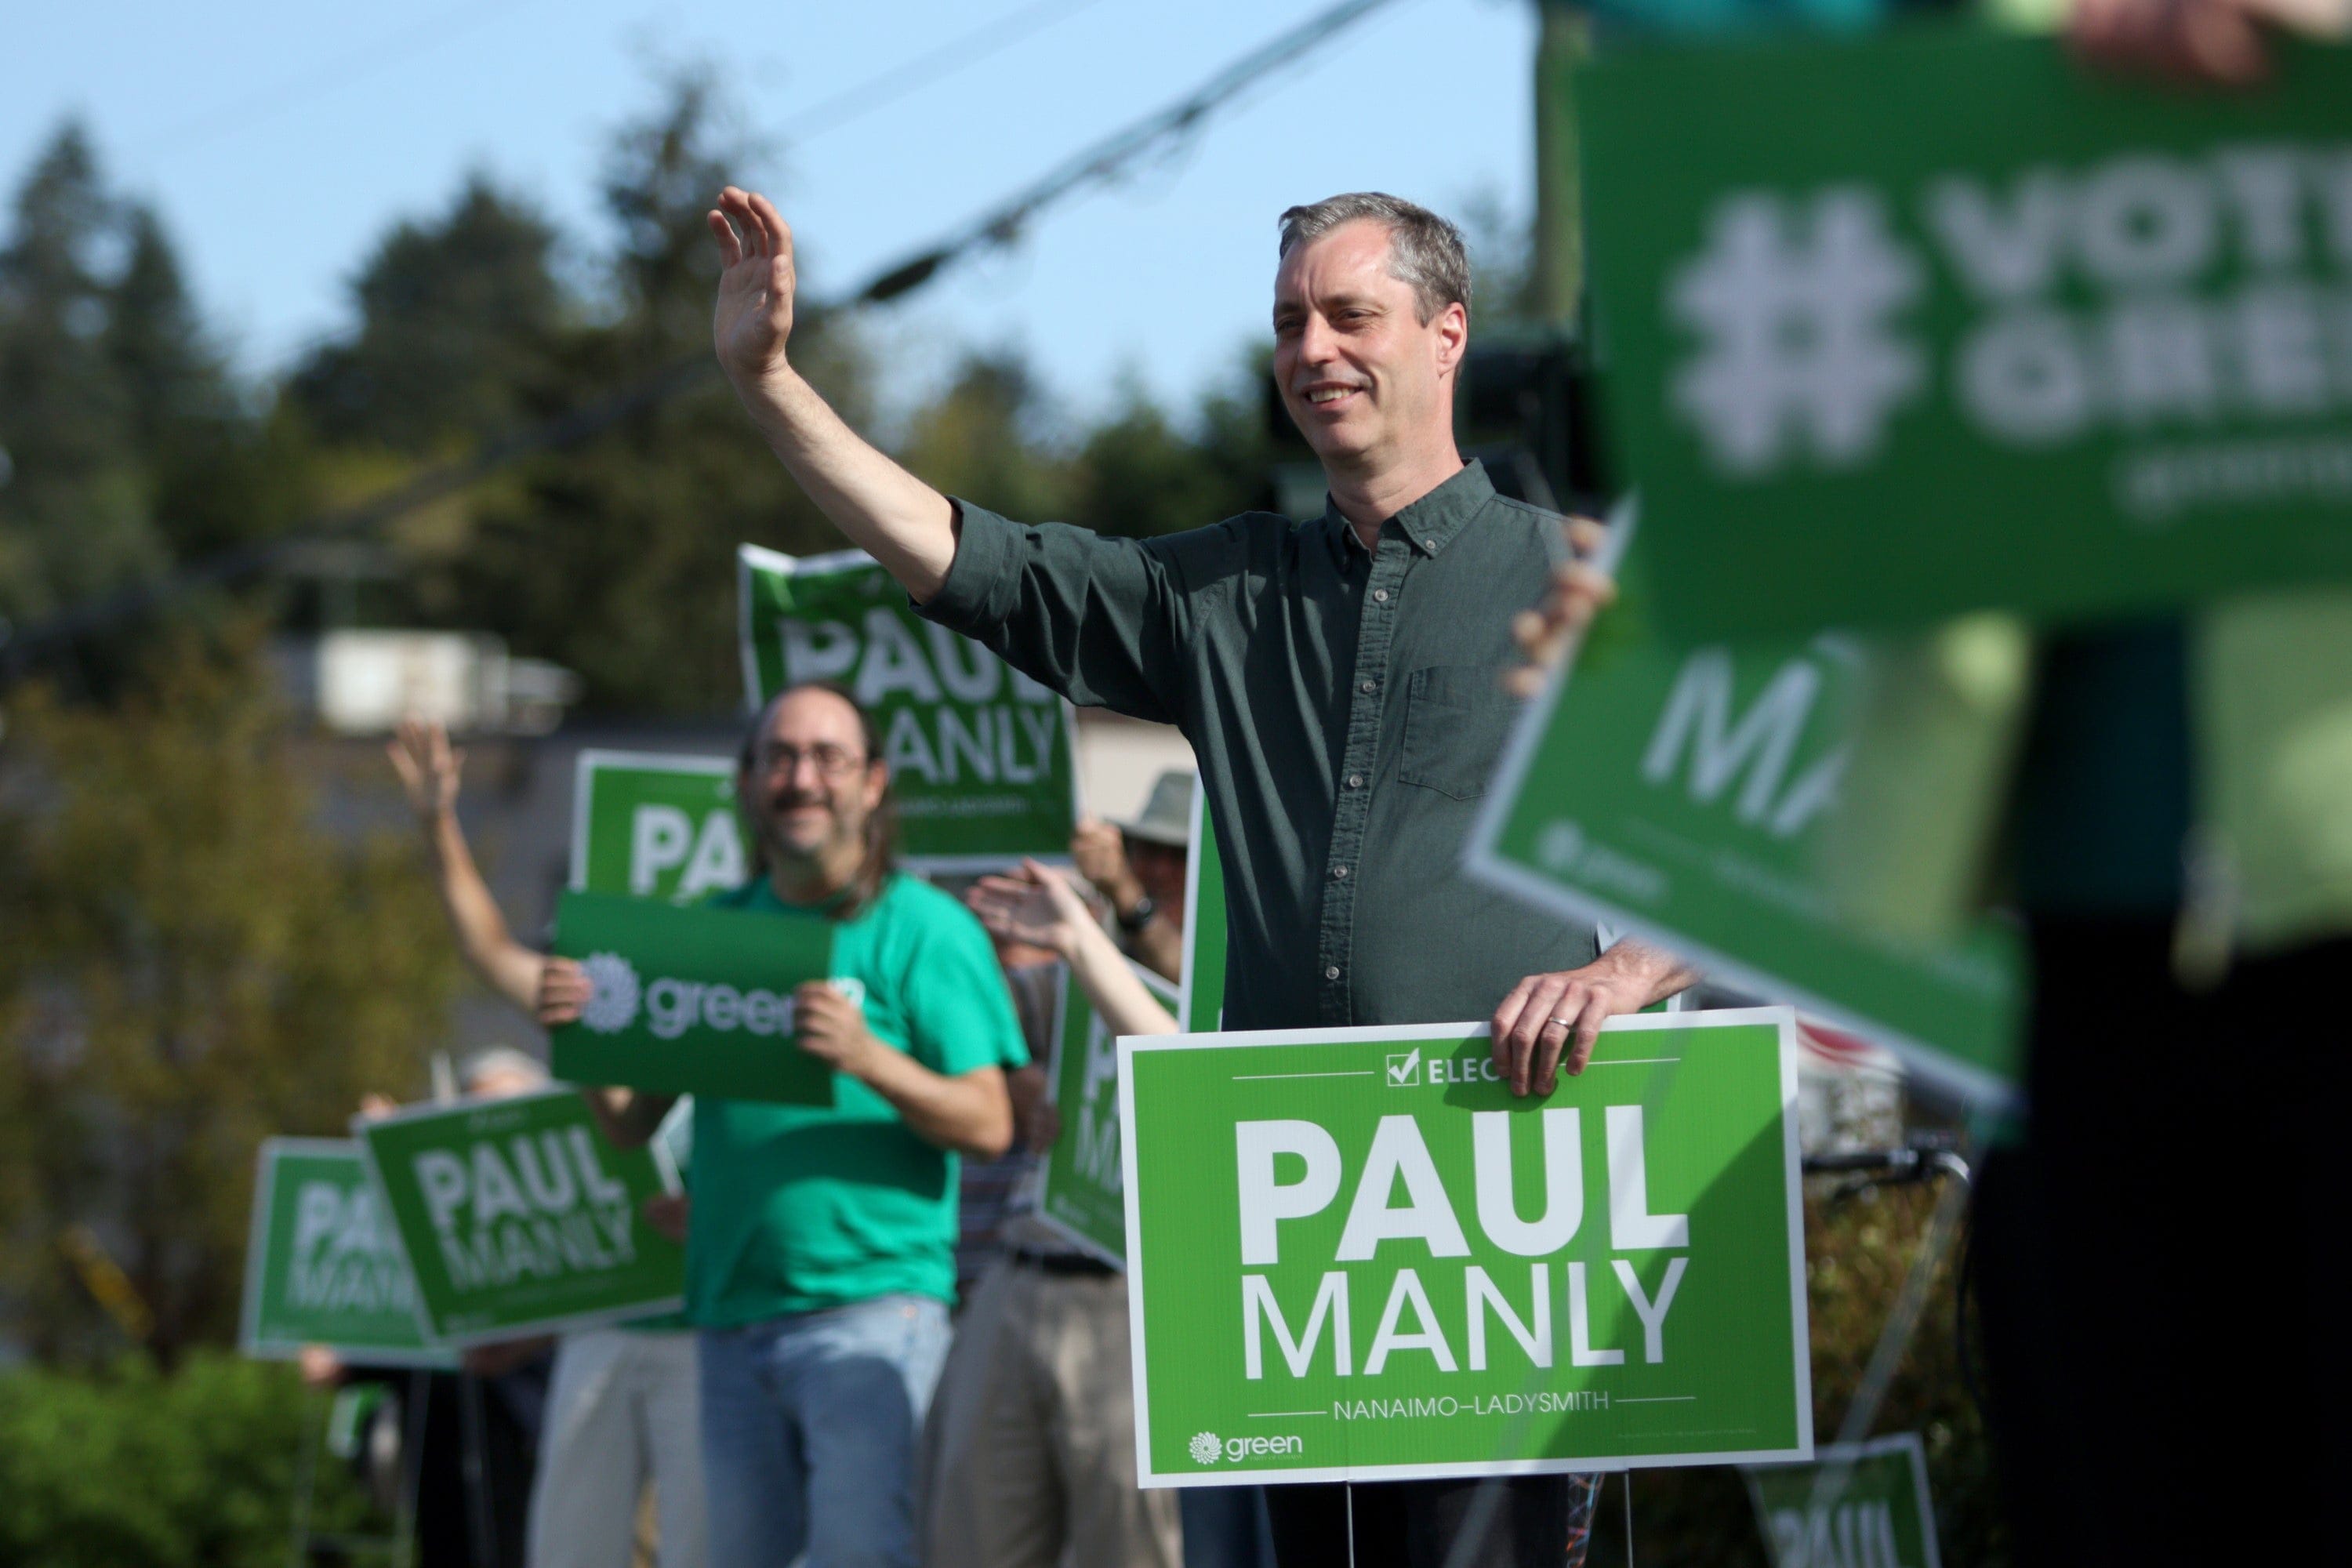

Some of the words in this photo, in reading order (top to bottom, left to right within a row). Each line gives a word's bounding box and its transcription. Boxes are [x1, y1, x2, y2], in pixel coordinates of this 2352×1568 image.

[884, 706, 1055, 783] ANLY
[632, 804, 746, 903] PA
[1428, 1058, 1501, 1084] ELEC
[295, 1181, 384, 1253] PA
[412, 1124, 626, 1228] PAUL
[1236, 1105, 1690, 1265] PAUL
[439, 1203, 635, 1295] MANLY
[1242, 1258, 1690, 1380] MANLY
[1226, 1436, 1302, 1462] green
